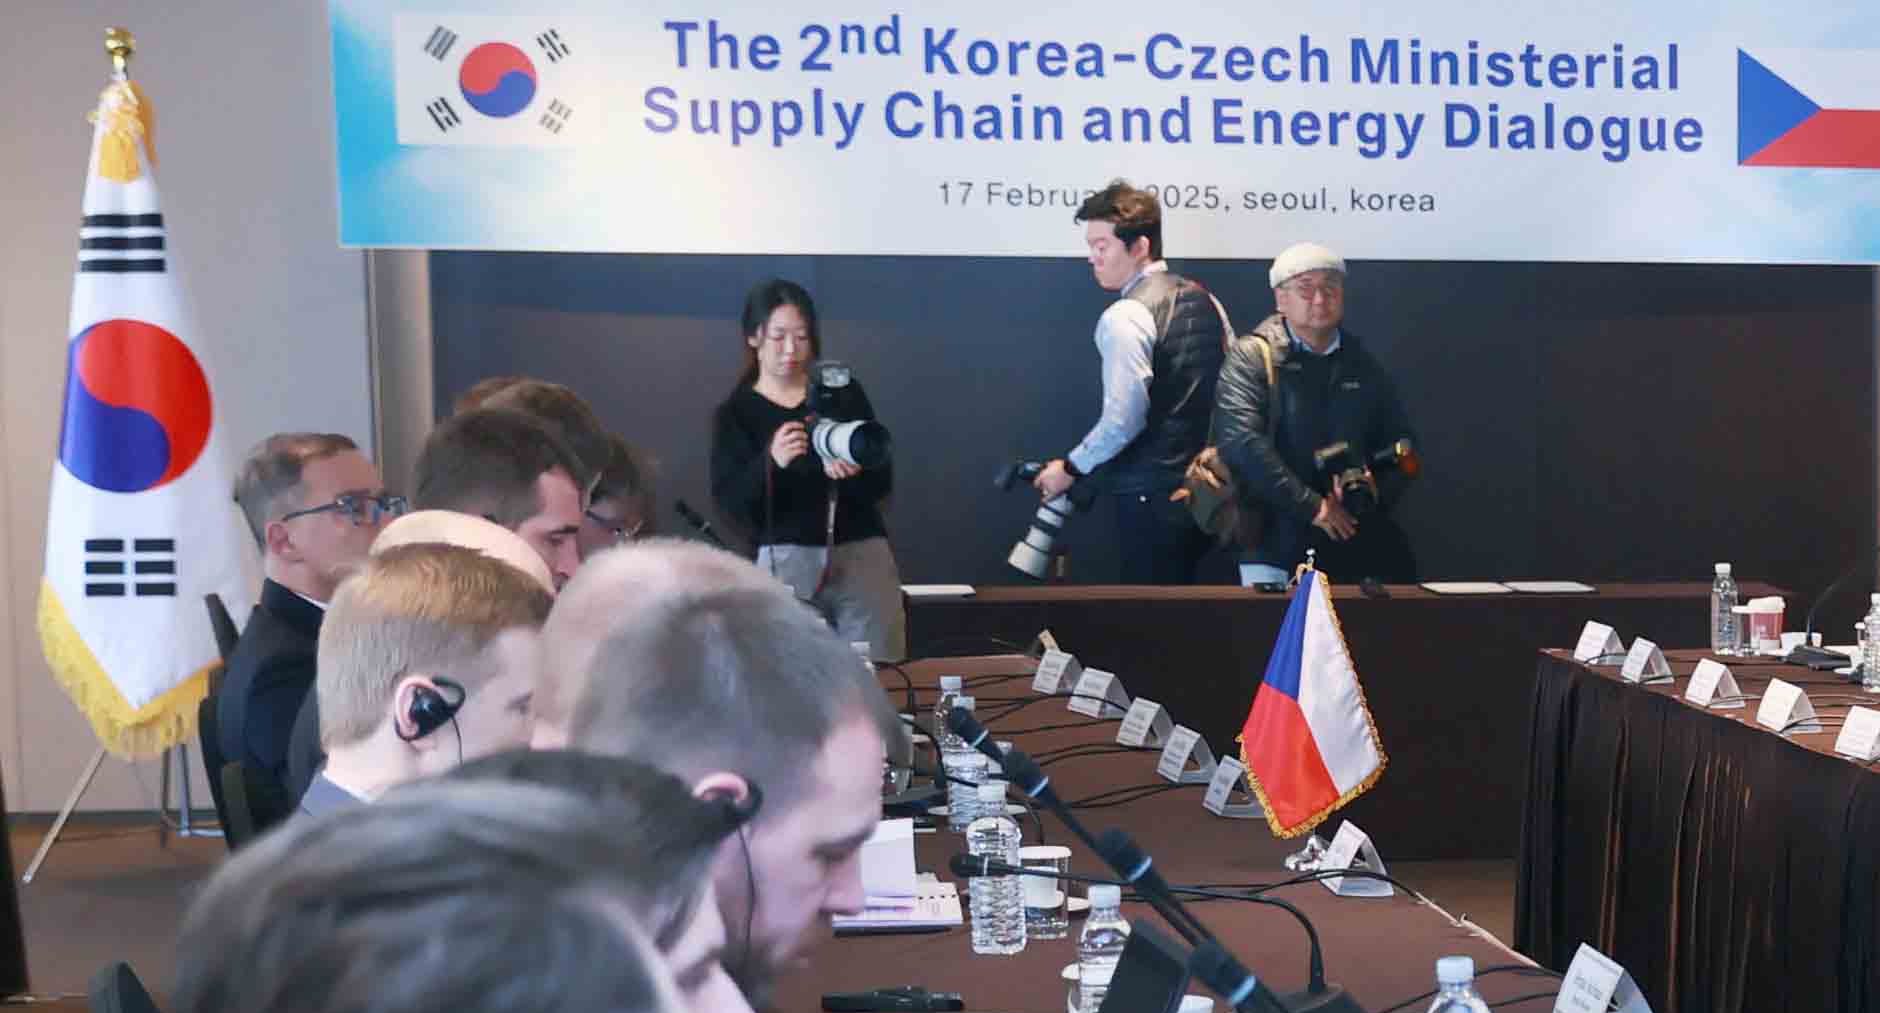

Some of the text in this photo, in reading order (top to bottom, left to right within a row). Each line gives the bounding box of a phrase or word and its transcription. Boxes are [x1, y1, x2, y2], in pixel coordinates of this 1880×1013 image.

[663, 13, 1680, 91] The 2nd Korea-Czech Ministerial
[644, 86, 1705, 163] Supply Chain and Energy Dialogue
[940, 182, 974, 206] 17
[987, 182, 1102, 208] Febru
[1243, 187, 1336, 215] seoul,
[1350, 187, 1435, 212] korea
